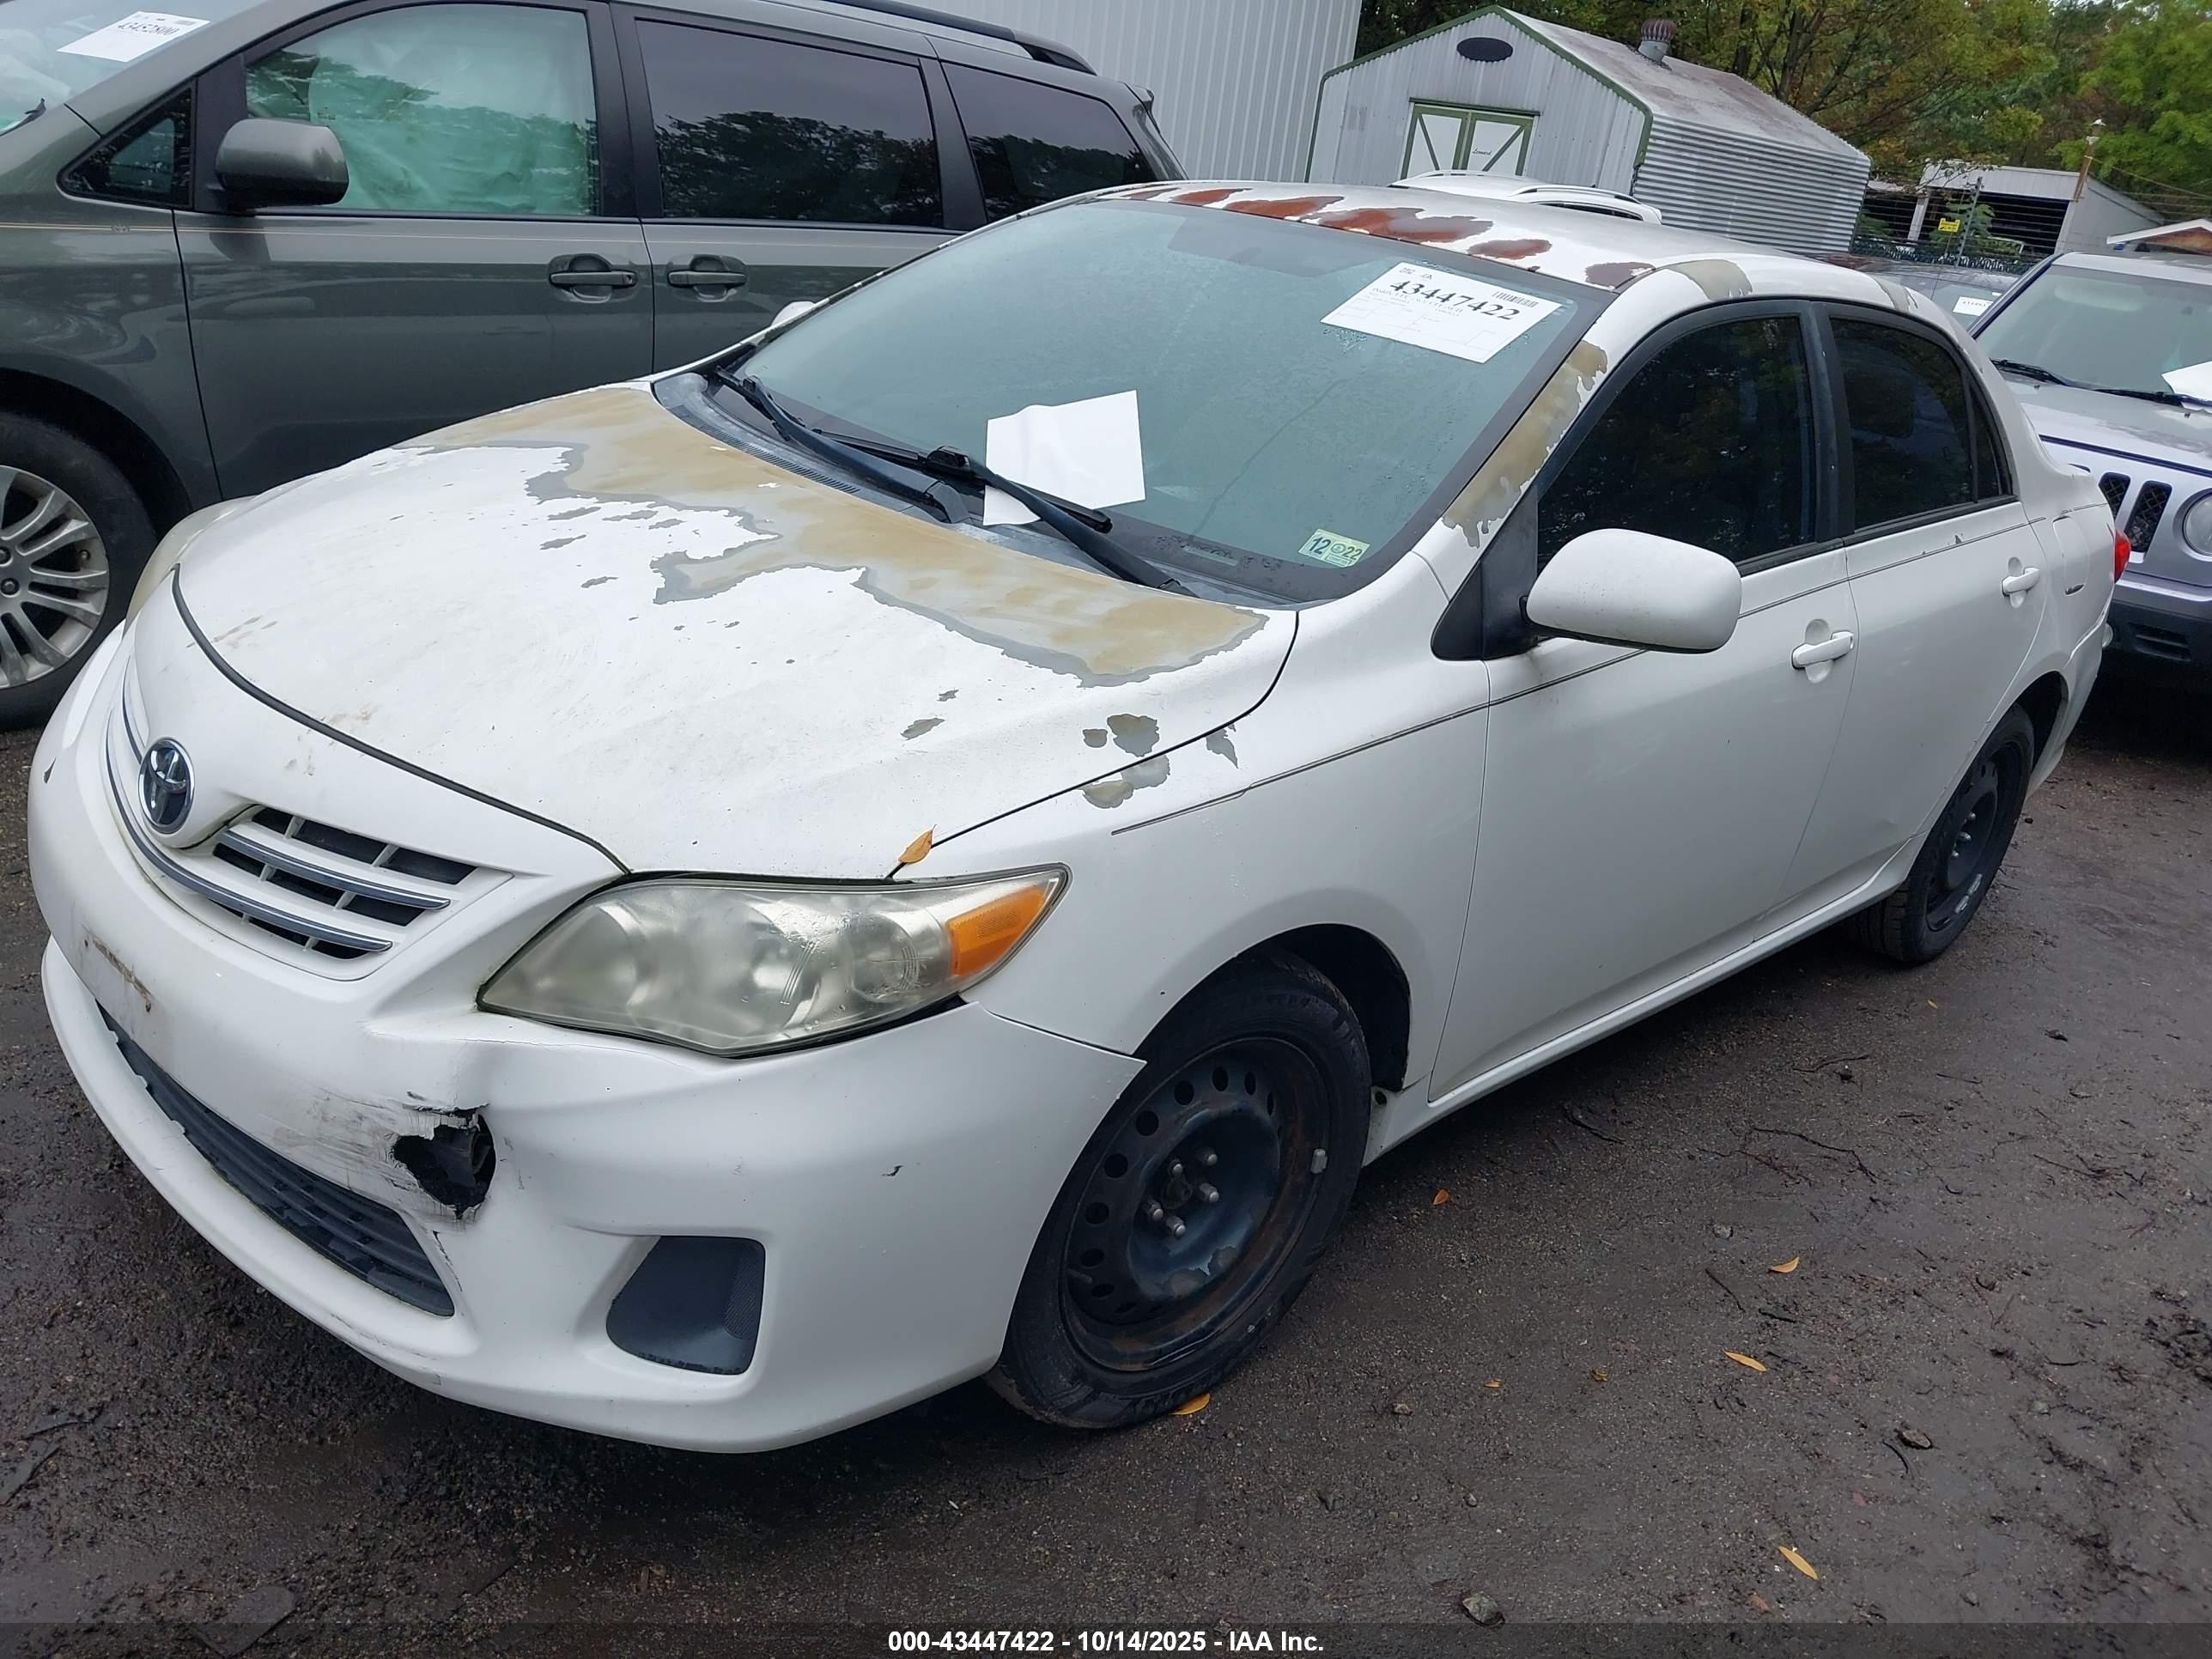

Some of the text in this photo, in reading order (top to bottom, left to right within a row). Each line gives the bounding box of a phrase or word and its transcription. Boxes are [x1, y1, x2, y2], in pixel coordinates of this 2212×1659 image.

[1389, 281, 1520, 319] 43447422
[1309, 537, 1363, 560] 12 22
